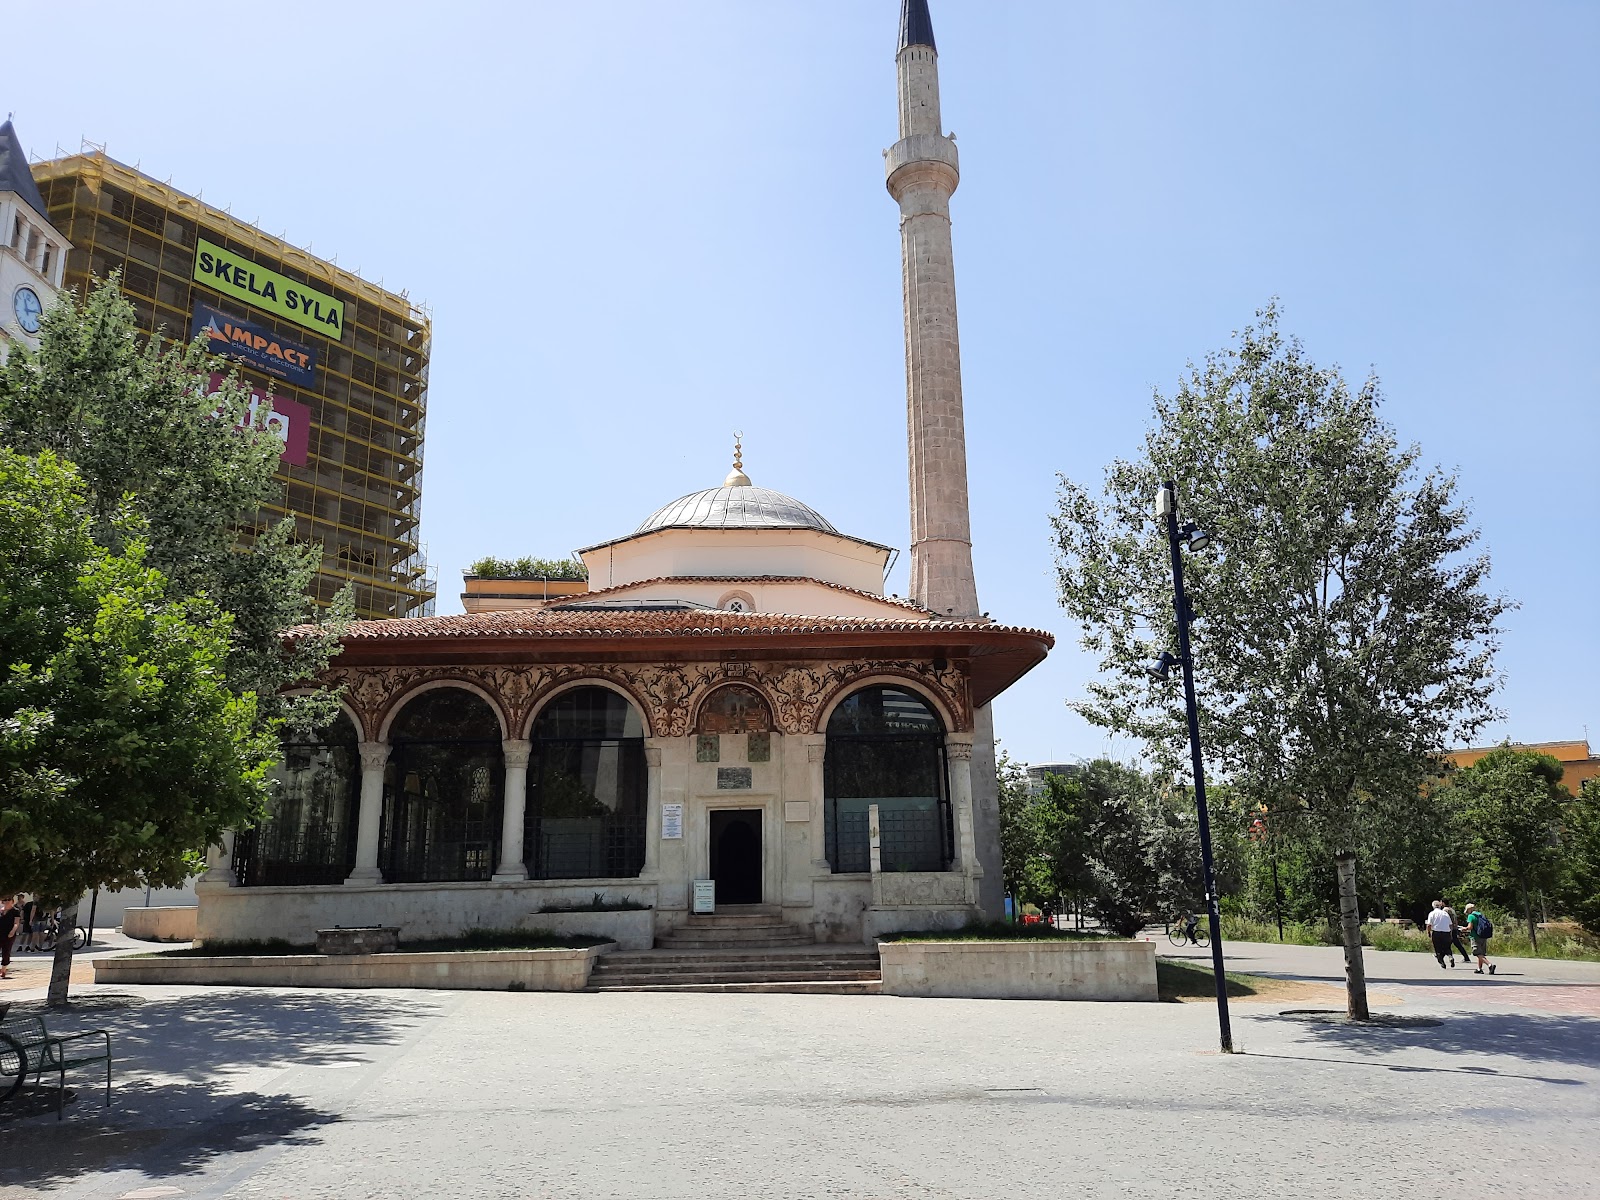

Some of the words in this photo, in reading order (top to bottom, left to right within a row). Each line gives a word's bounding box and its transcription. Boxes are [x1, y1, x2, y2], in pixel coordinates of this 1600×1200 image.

[199, 251, 278, 303] SKELA
[285, 289, 340, 330] SYLA
[224, 322, 310, 368] IMPACT
[231, 341, 259, 357] electric
[269, 356, 305, 374] electronic
